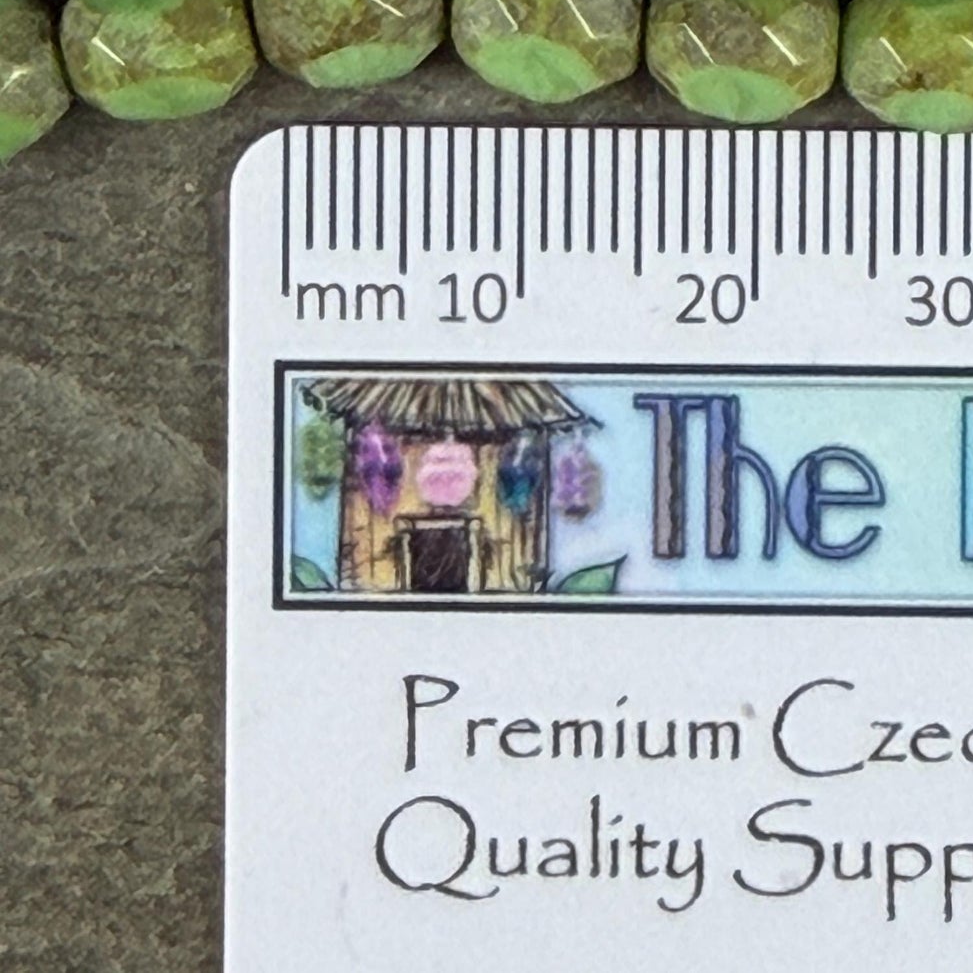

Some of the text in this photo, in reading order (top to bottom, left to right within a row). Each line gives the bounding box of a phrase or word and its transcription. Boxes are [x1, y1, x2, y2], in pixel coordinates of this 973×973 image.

[295, 281, 407, 321] mm
[438, 272, 508, 324] 10
[675, 273, 746, 325] 20
[632, 393, 886, 561] The
[402, 674, 741, 773] Premium
[374, 794, 705, 914] Quality
